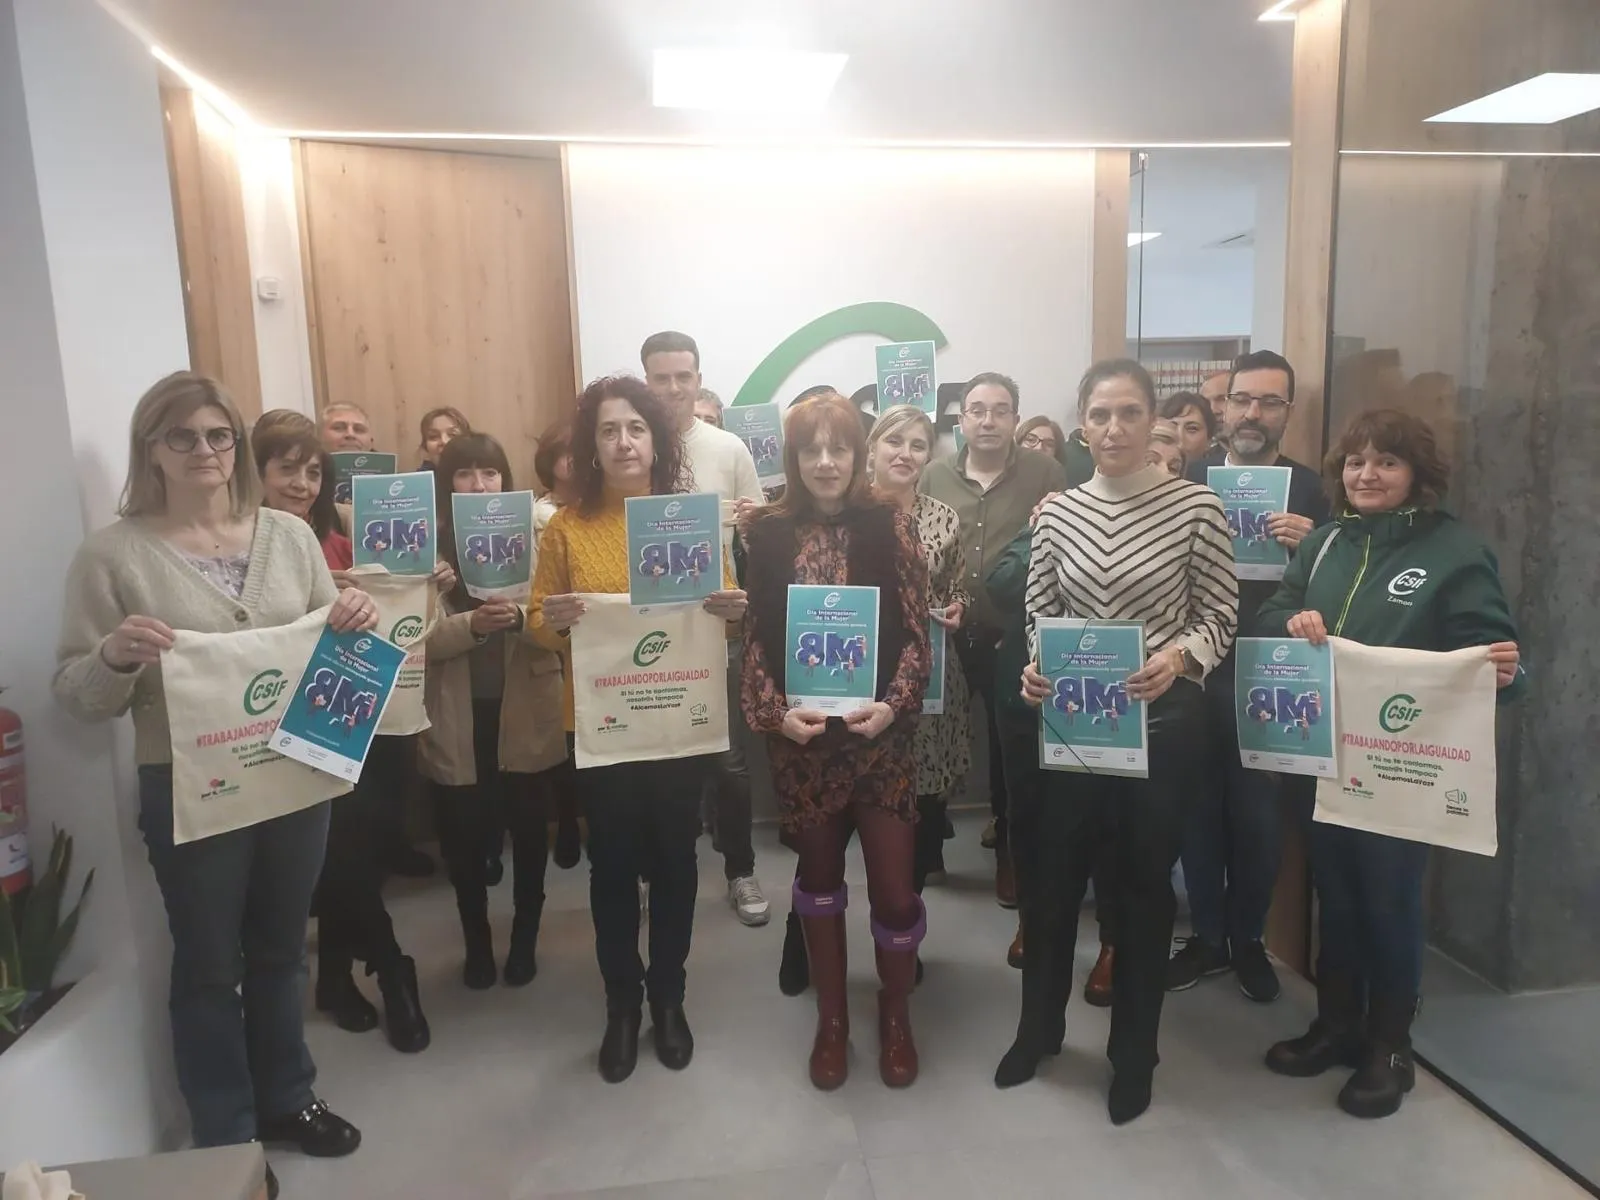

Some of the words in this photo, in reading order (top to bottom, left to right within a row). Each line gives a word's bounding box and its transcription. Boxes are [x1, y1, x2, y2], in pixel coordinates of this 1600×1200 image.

[796, 632, 867, 669] 8M
[1088, 659, 1109, 667] Mujer
[594, 669, 711, 688] #TRABAJANDOPORLAIGUALDAD
[1053, 676, 1132, 717] 8M
[1246, 686, 1321, 725] 8M
[1342, 733, 1471, 762] #TRABAJANDOPORLAIGUALDAD
[1404, 767, 1438, 778] tampoco
